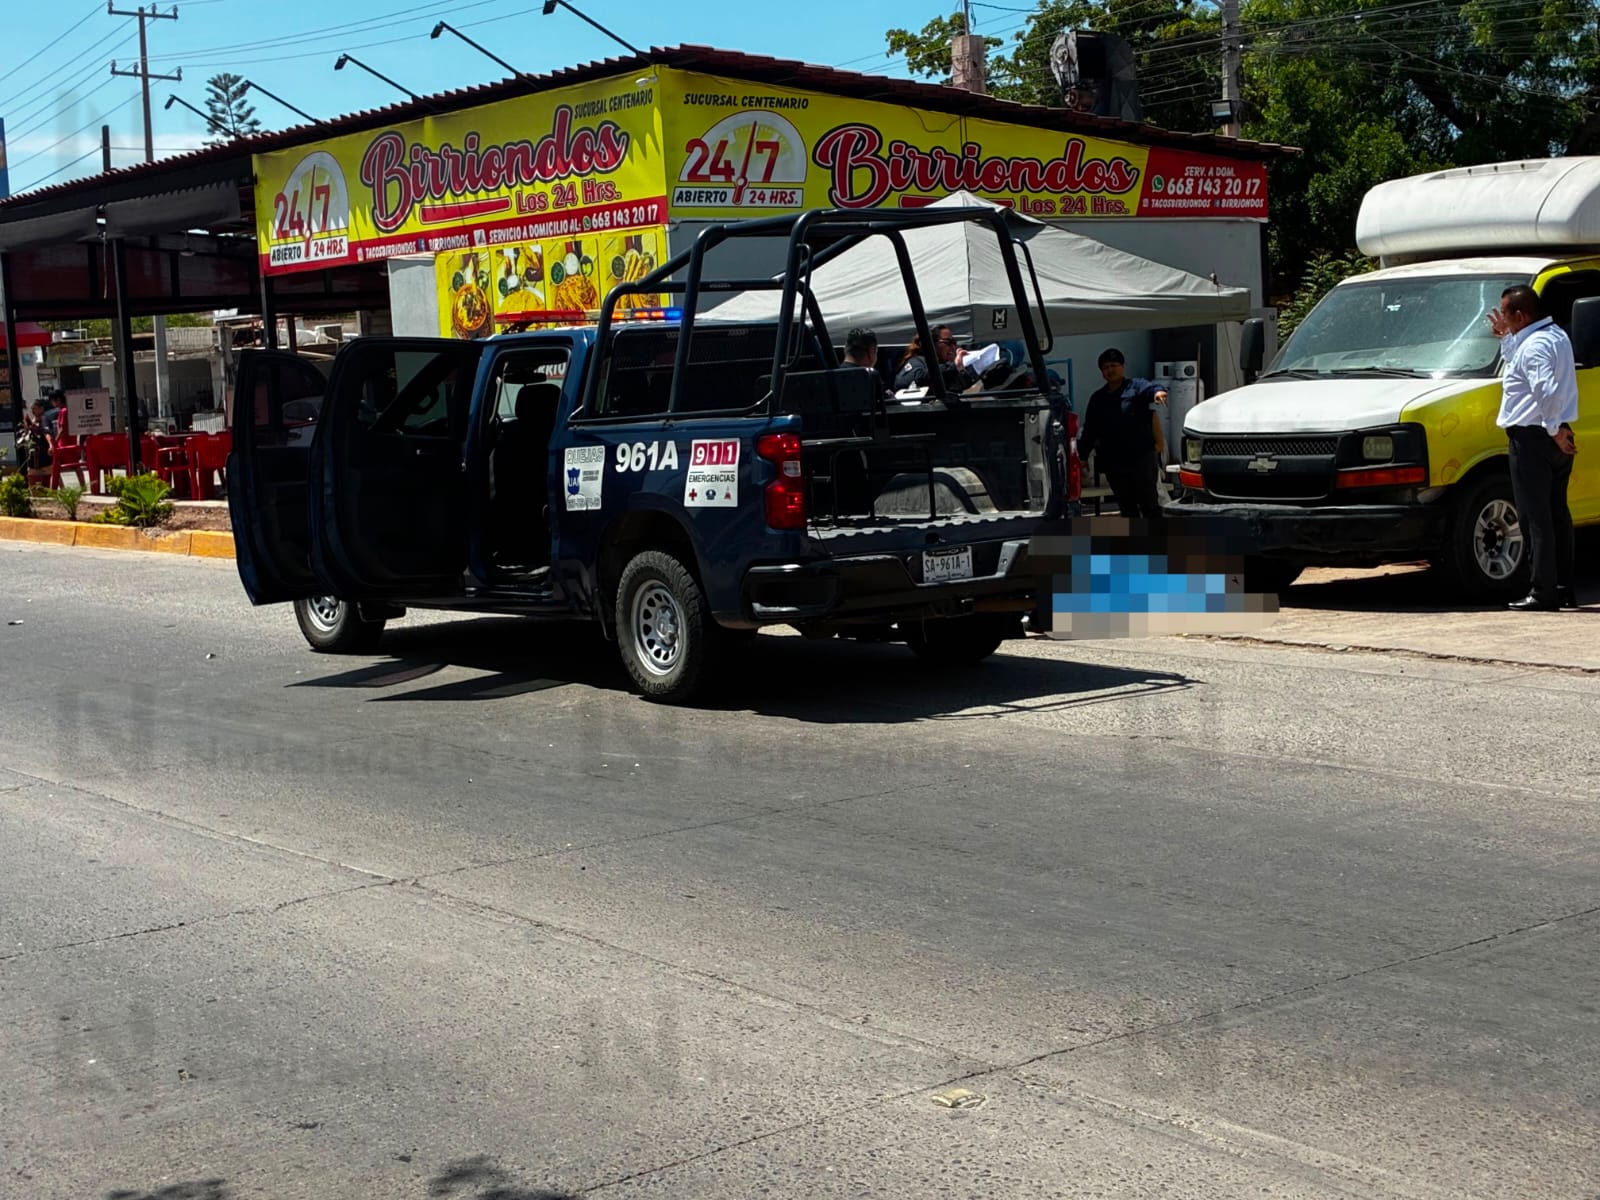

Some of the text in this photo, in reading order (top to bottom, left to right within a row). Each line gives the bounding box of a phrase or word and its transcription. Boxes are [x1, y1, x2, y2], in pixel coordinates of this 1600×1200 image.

[574, 88, 653, 119] SUCURSAL CENTENARIO
[683, 93, 809, 109] SUCURSAL CENTENARIO
[361, 104, 629, 232] Birriondos
[812, 122, 1140, 209] Birriondos
[1184, 166, 1236, 177] SERV. A DOM.
[516, 178, 621, 214] Los 24 Hrs.
[1167, 178, 1261, 196] 668 143 20 17
[676, 190, 798, 205] ABIERTO 24 HRS.
[1020, 195, 1129, 215] Los 24 Hrs.
[1221, 198, 1264, 208] BIRRIONDOS
[489, 226, 522, 243] SERVICIO
[522, 223, 528, 235] A
[529, 220, 568, 236] DOMICILIO
[591, 211, 610, 229] 668
[613, 208, 630, 226] 143
[632, 206, 645, 224] 20
[647, 204, 658, 221] 17
[271, 238, 345, 262] ABIERTO 24 HRS.
[428, 234, 469, 250] BIRRIONDOS
[85, 398, 94, 410] E
[615, 440, 679, 473] 961A
[694, 442, 735, 465] 911
[688, 474, 736, 483] EMERGENCIAS
[925, 555, 970, 573] SA-961A-1
